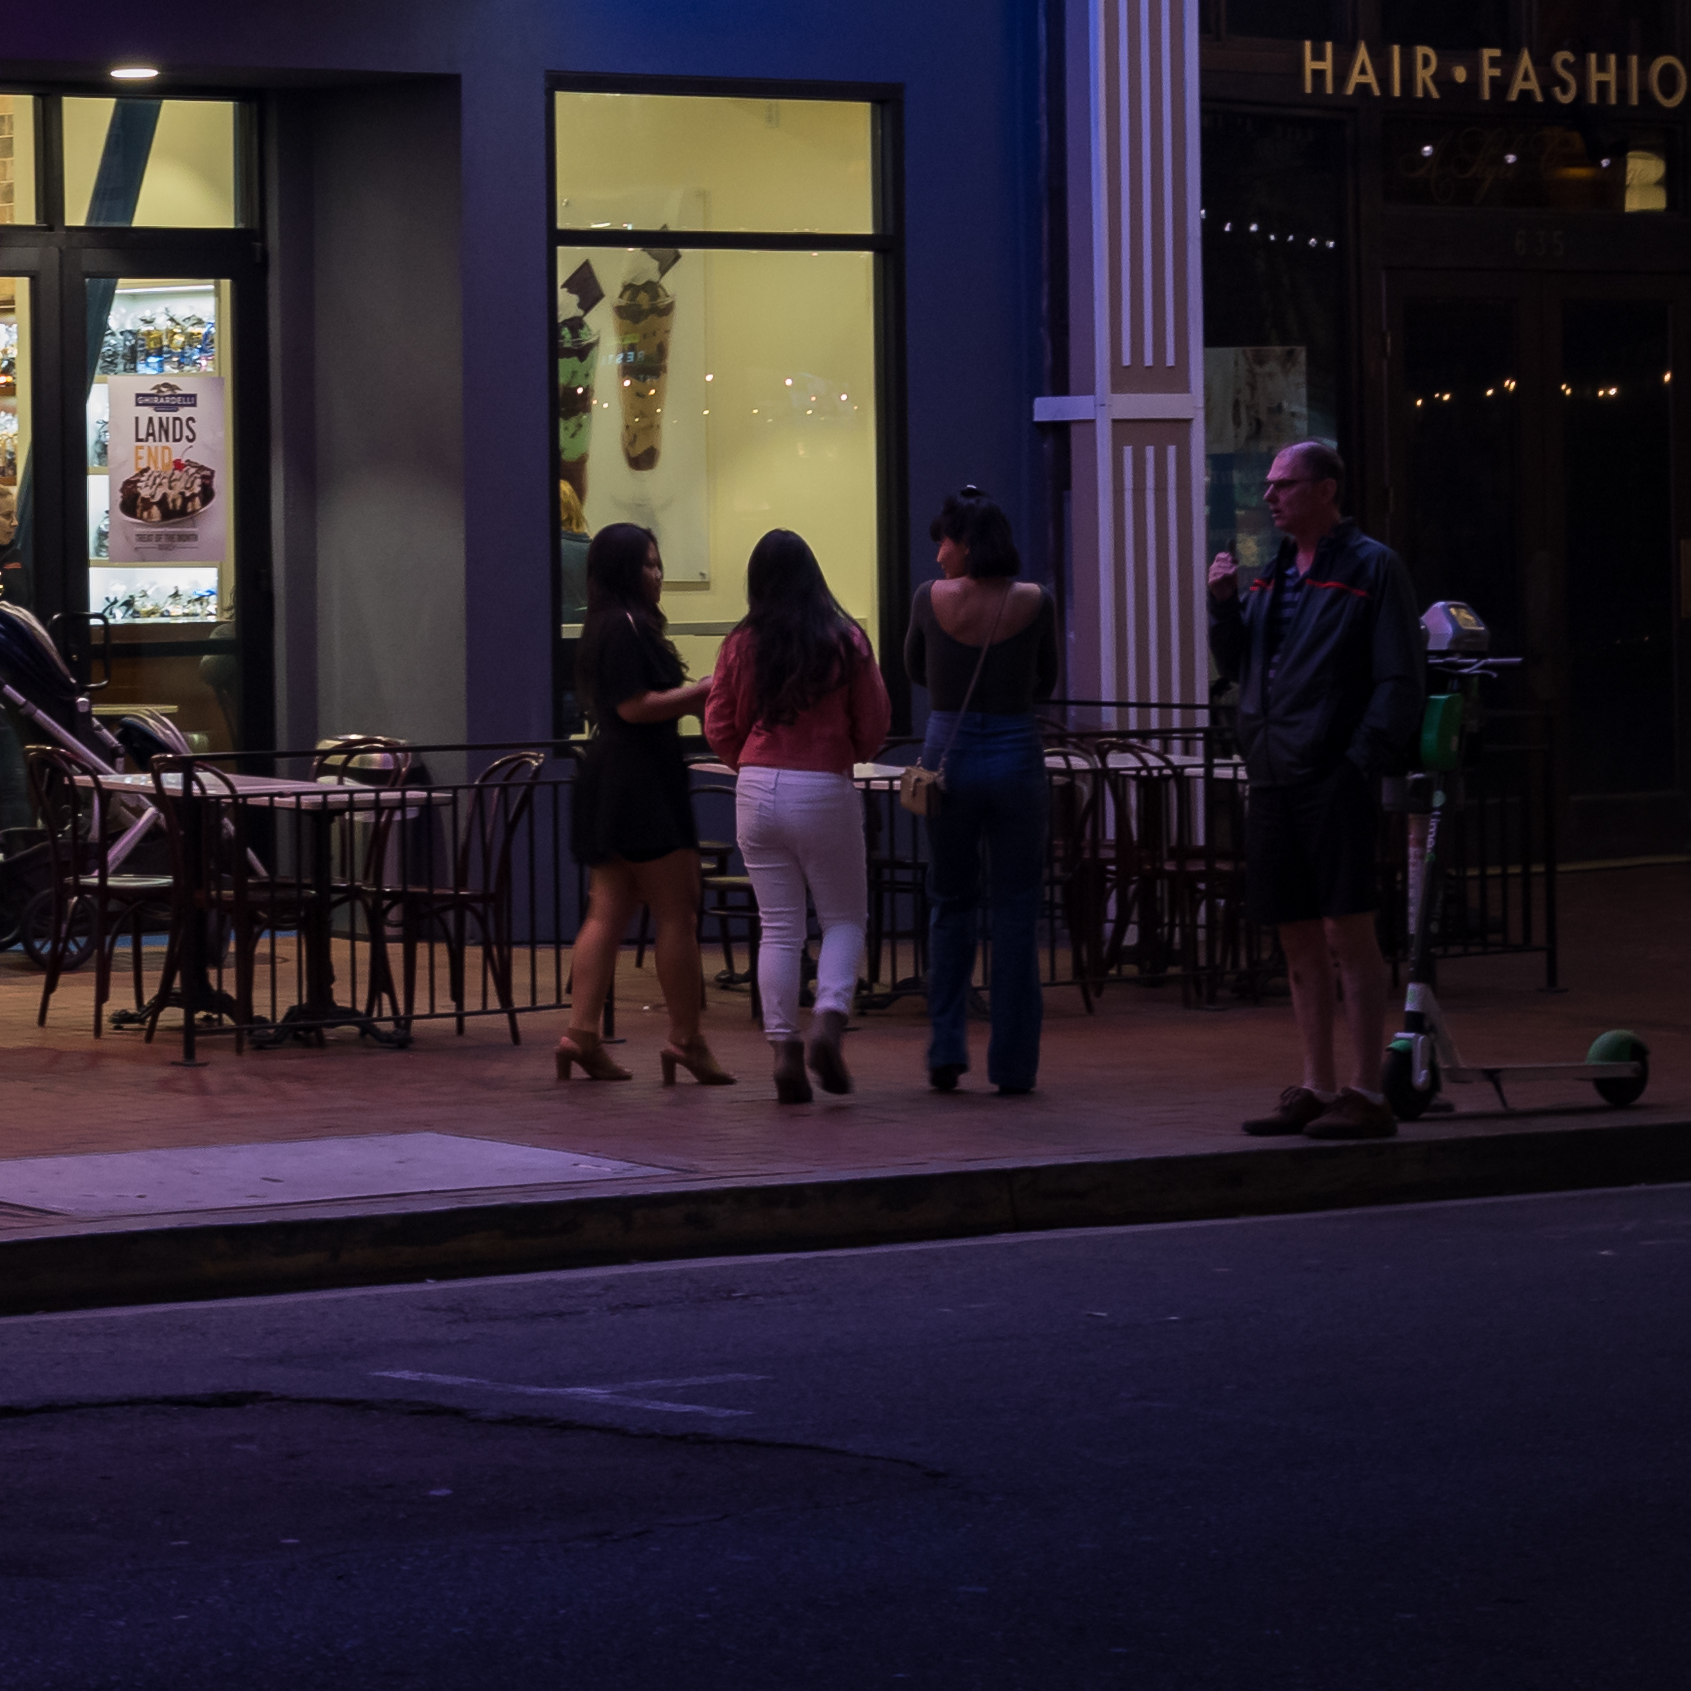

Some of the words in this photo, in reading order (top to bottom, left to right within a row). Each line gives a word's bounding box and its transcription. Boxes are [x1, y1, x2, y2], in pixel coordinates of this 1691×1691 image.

[1514, 229, 1566, 258] 635
[136, 396, 195, 405] GHIRARDELLI
[134, 416, 197, 443] LANDS
[134, 445, 173, 473] END
